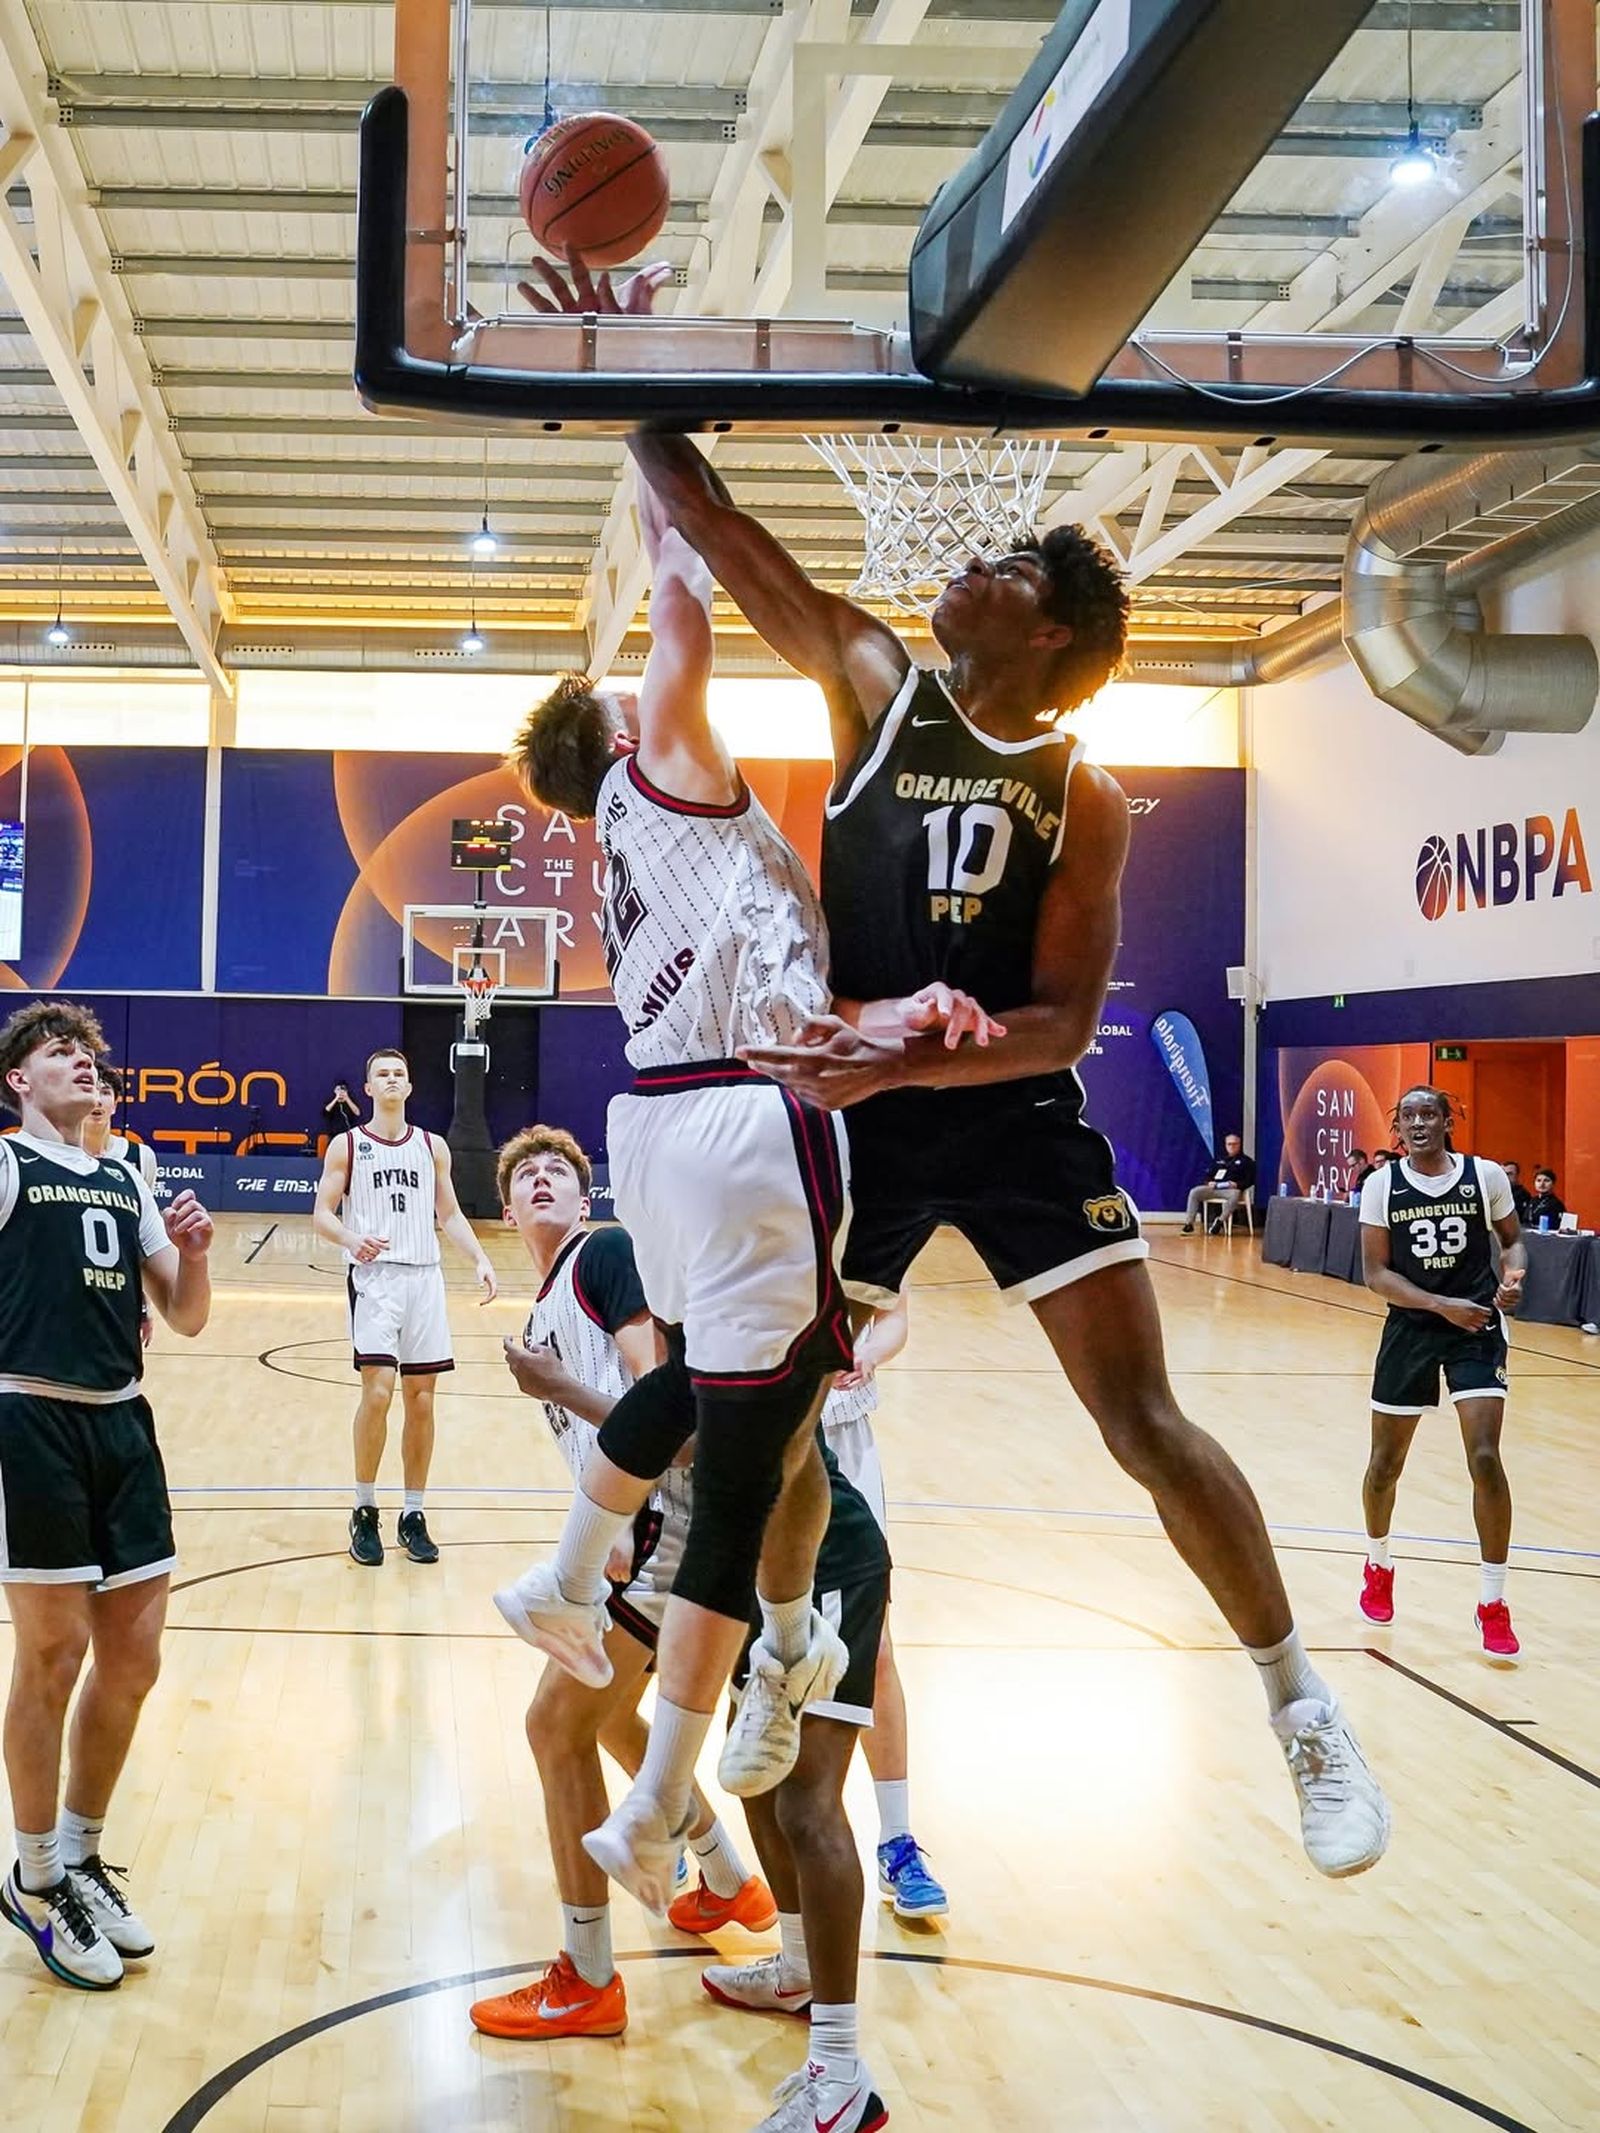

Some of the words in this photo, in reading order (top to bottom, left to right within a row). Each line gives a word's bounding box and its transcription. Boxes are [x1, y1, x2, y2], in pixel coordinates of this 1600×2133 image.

[496, 804, 602, 844] SA
[922, 803, 1013, 896] 10
[1456, 808, 1592, 912] NBPA
[544, 859, 574, 870] THE
[492, 910, 606, 948] AR
[1316, 1089, 1355, 1117] SAN
[156, 1166, 204, 1179] GLOBAL
[373, 1168, 419, 1189] RYTAS
[236, 1178, 268, 1191] THE
[390, 1192, 406, 1213] 16
[1391, 1203, 1478, 1223] ORANGEVILLE
[81, 1207, 120, 1268] 0
[1409, 1216, 1468, 1258] 33
[1423, 1255, 1457, 1270] PREP
[83, 1268, 126, 1291] PREP
